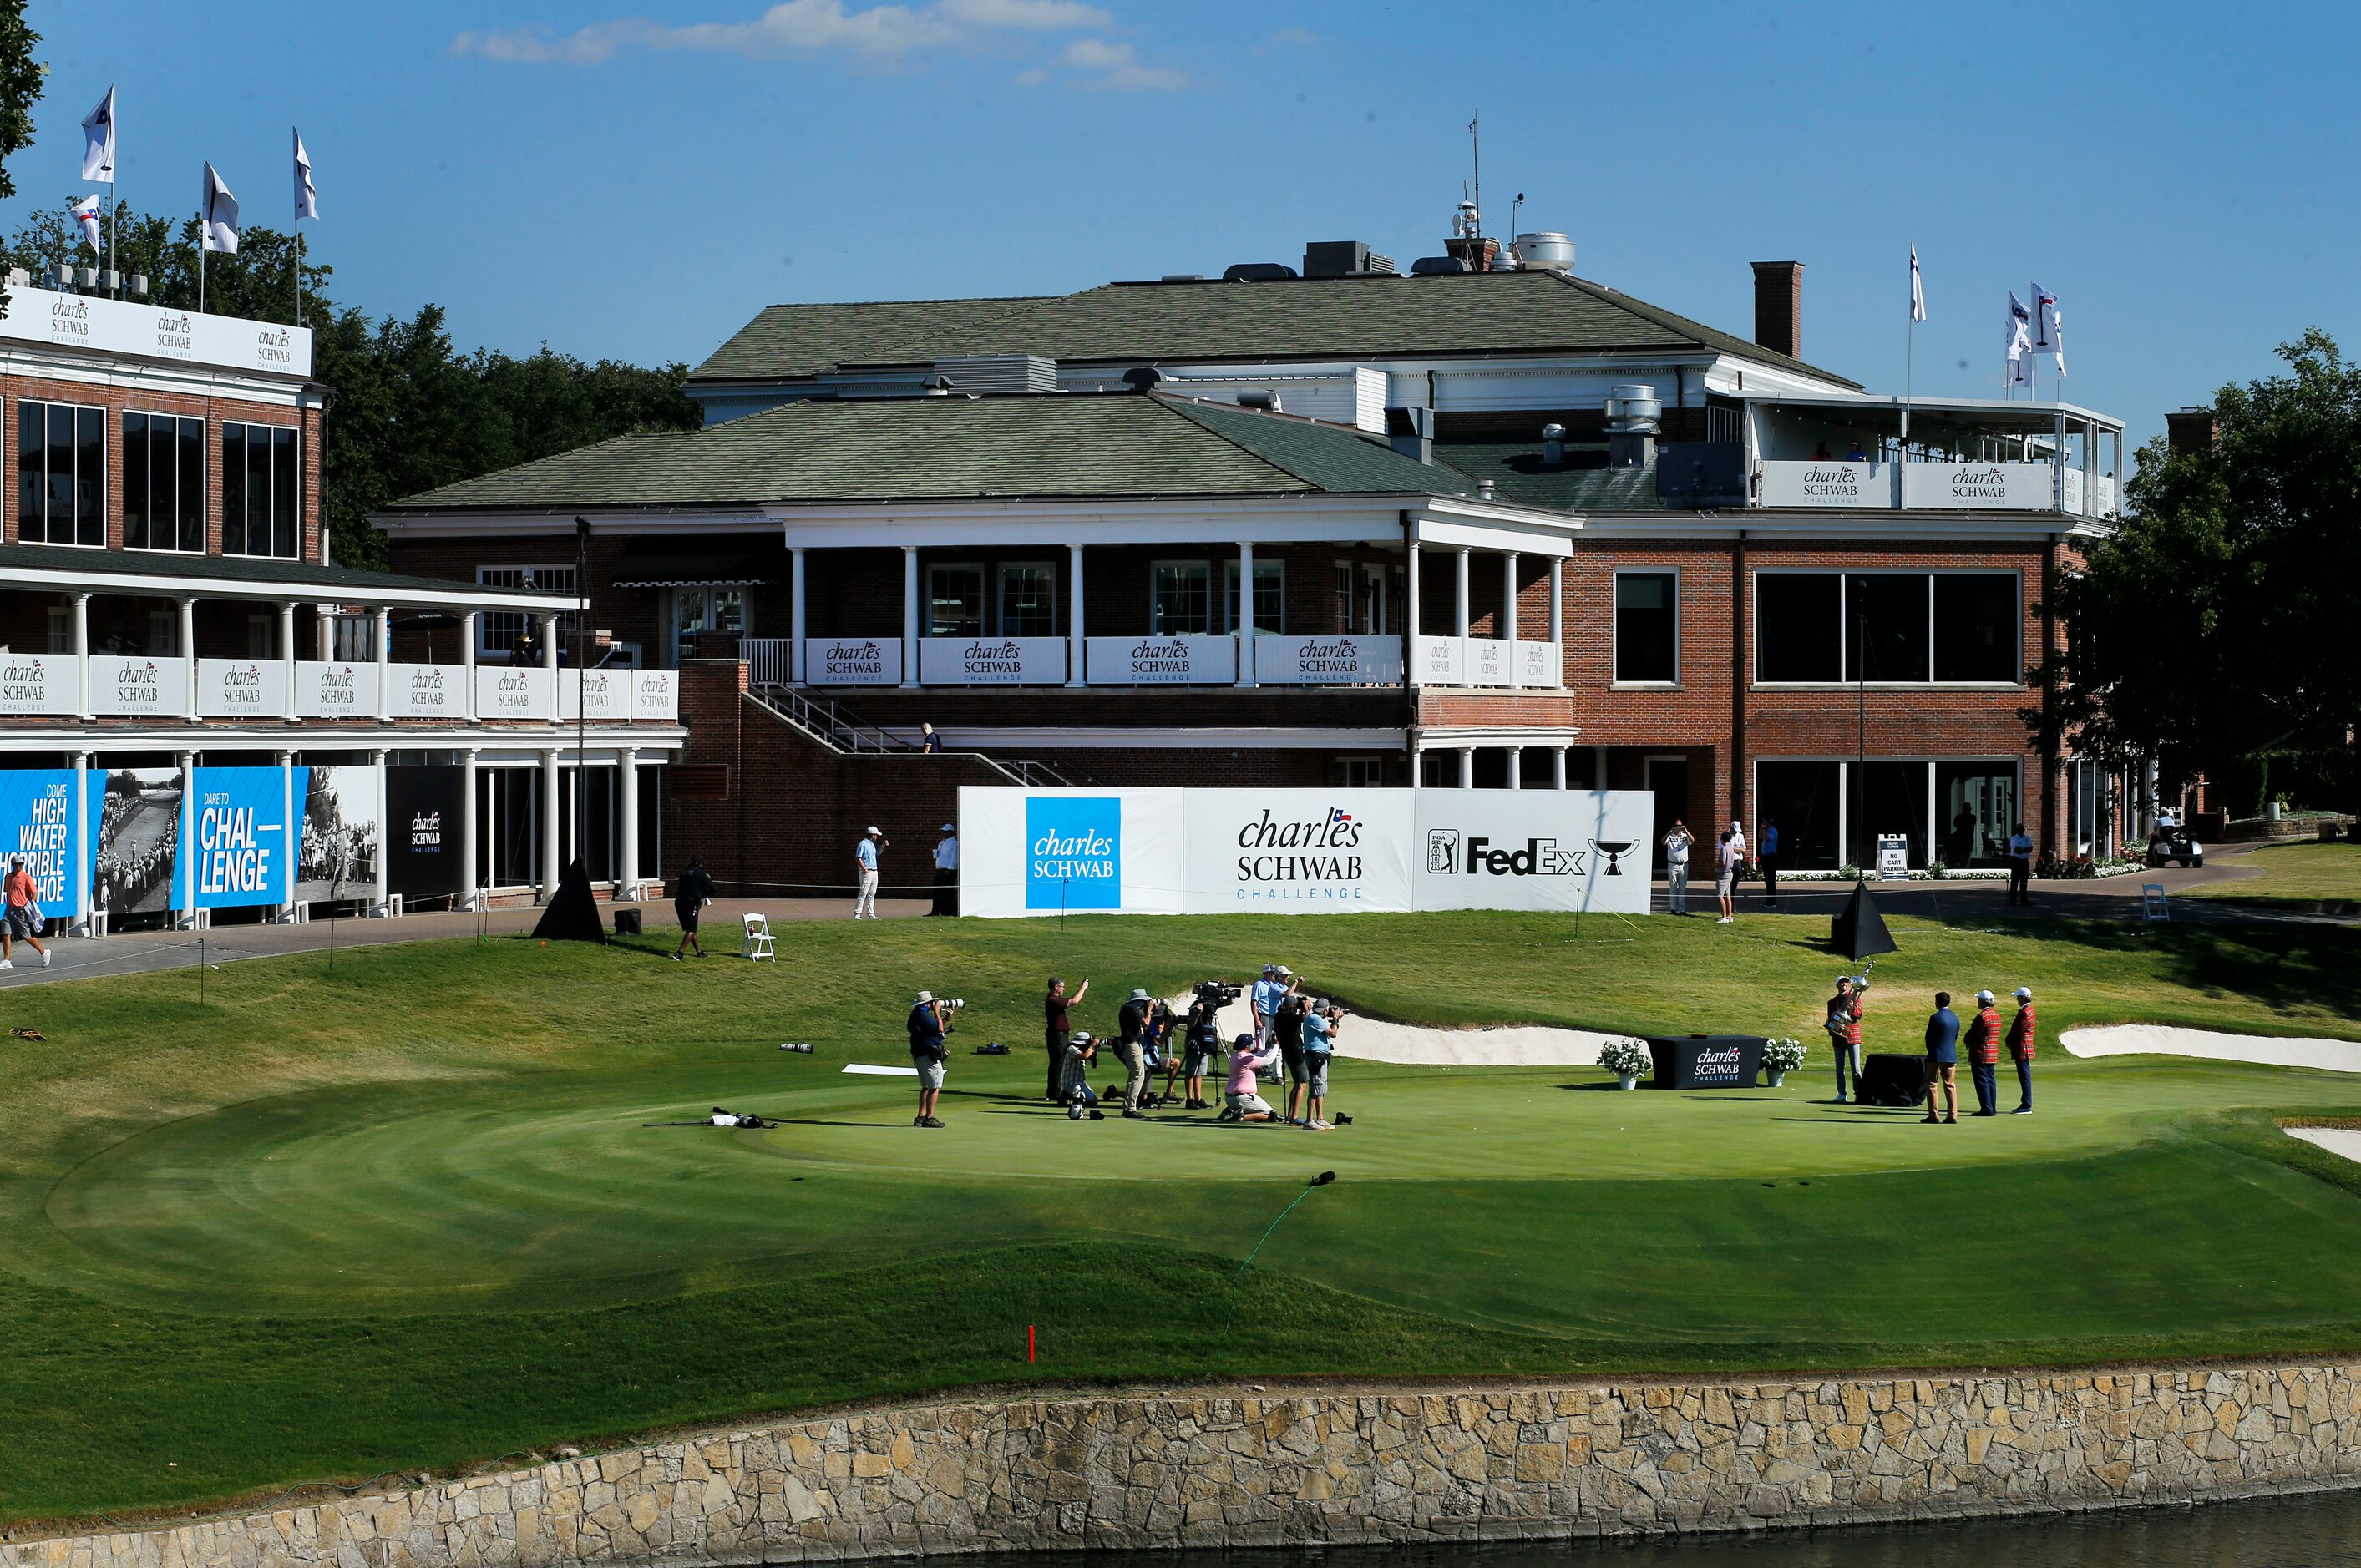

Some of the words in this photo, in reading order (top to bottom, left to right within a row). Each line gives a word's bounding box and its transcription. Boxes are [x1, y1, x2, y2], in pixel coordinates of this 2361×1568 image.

[53, 296, 89, 319] charles
[52, 318, 89, 336] SCHWAB
[158, 311, 190, 333] charles
[157, 333, 191, 349] SCHWAB
[258, 326, 290, 347] charles
[258, 347, 290, 363] SCHWAB
[1804, 466, 1857, 483] charles
[1953, 468, 2005, 484] charles
[1804, 485, 1857, 495] SCHWAB
[1953, 487, 2005, 497] SCHWAB
[826, 640, 881, 660] charles
[965, 640, 1021, 659] charles
[1132, 639, 1189, 658] charles
[1299, 639, 1357, 658] charles
[3, 659, 44, 682] charles
[119, 661, 158, 684] charles
[225, 664, 260, 685] charles
[826, 662, 882, 674] SCHWAB
[965, 662, 1021, 673] SCHWAB
[1132, 660, 1190, 672] SCHWAB
[1299, 660, 1357, 672] SCHWAB
[321, 666, 354, 687] charles
[412, 668, 443, 689] charles
[499, 671, 529, 690] charles
[641, 674, 669, 693] charles
[3, 685, 45, 701] SCHWAB
[118, 687, 158, 701] SCHWAB
[224, 689, 260, 703] SCHWAB
[321, 690, 354, 703] SCHWAB
[411, 691, 443, 705] SCHWAB
[499, 694, 529, 706] SCHWAB
[583, 695, 609, 707] CHWAB
[641, 695, 669, 708] SCHWAB
[47, 784, 67, 798] COME
[204, 793, 220, 805] DARE
[221, 792, 229, 805] TO
[33, 798, 67, 824] HIGH
[412, 811, 440, 831] charles
[1238, 806, 1363, 848] charles
[19, 824, 67, 851] WATER
[412, 832, 440, 845] SCHWAB
[1034, 828, 1113, 856] charles
[1431, 840, 1441, 871] TOUR
[1467, 837, 1587, 876] FedEx
[200, 849, 270, 893] LENGE
[1034, 860, 1114, 878] SCHWAB
[1237, 856, 1363, 882] SCHWAB
[1236, 888, 1362, 899] CHALLENGE
[1697, 1046, 1740, 1064] charles
[1695, 1064, 1739, 1075] SCHWAB
